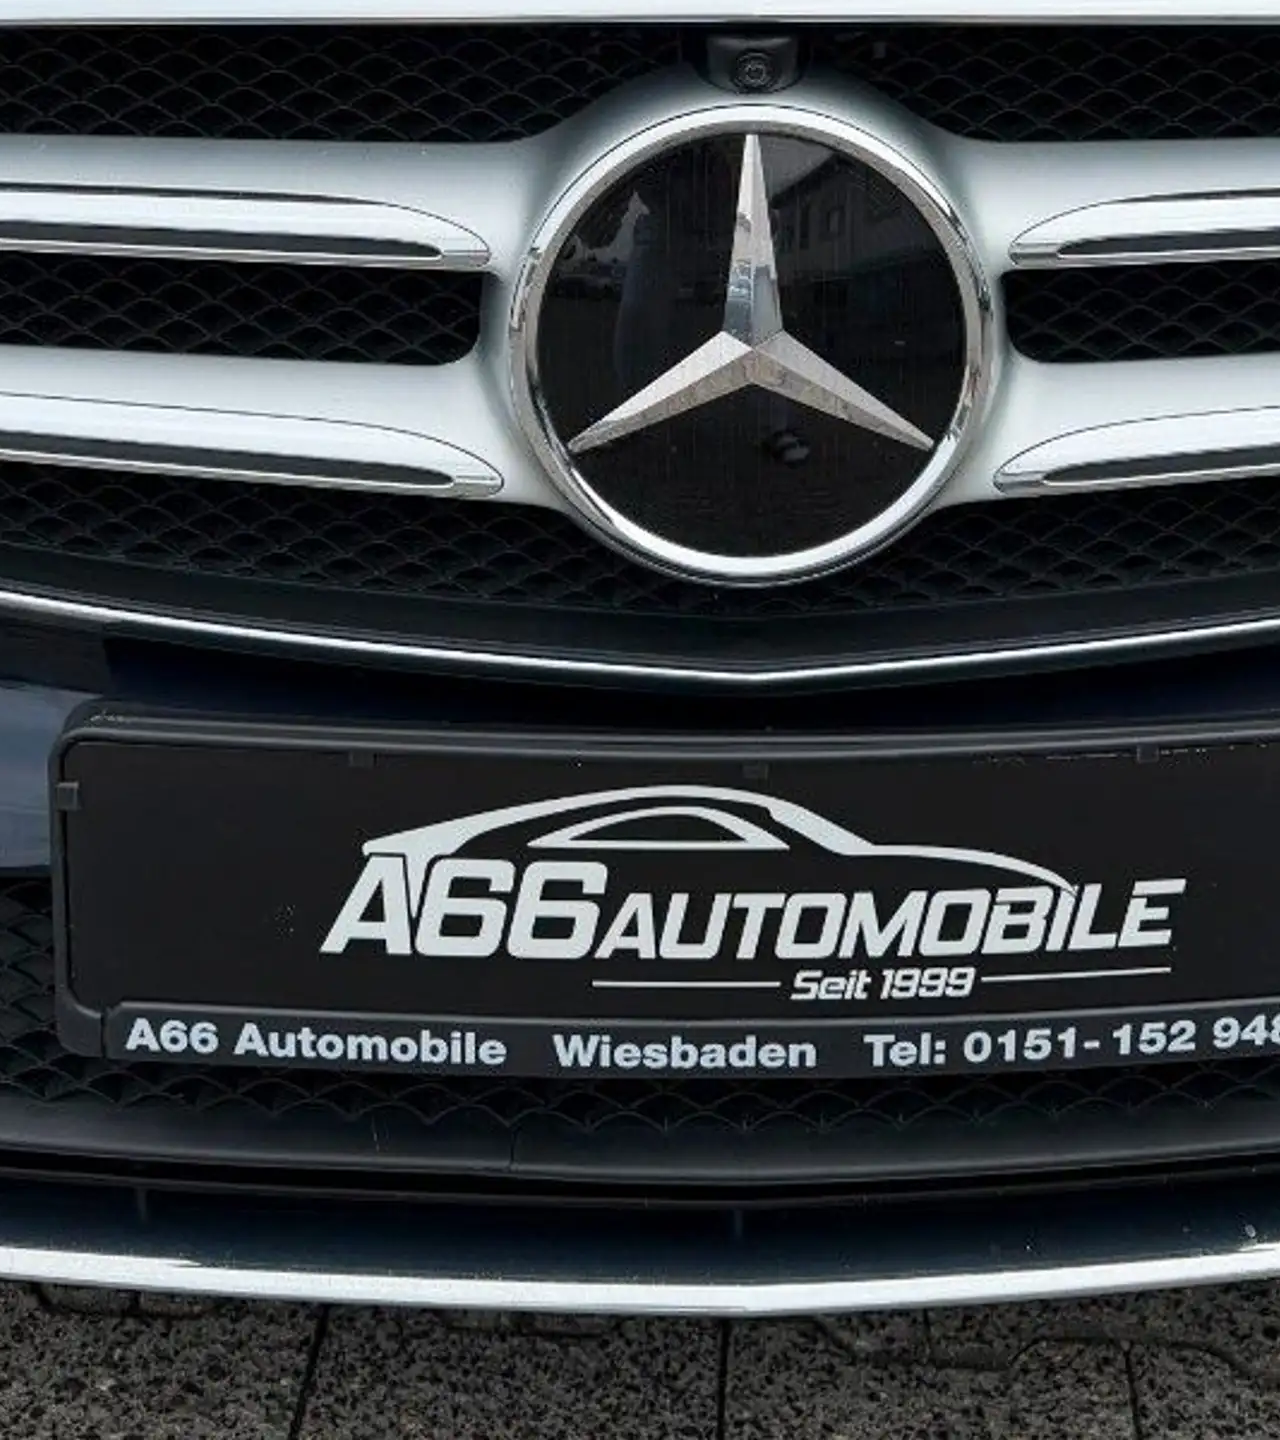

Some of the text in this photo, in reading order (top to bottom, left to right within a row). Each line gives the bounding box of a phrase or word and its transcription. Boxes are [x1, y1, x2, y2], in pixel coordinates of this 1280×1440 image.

[320, 856, 1187, 959] A66AUTOMOBILE
[790, 966, 976, 1000] Seit 1999
[125, 1017, 219, 1054] A66
[233, 1022, 508, 1065] Automobile
[553, 1034, 818, 1069] Wiesbaden
[863, 1032, 946, 1068] Tel:
